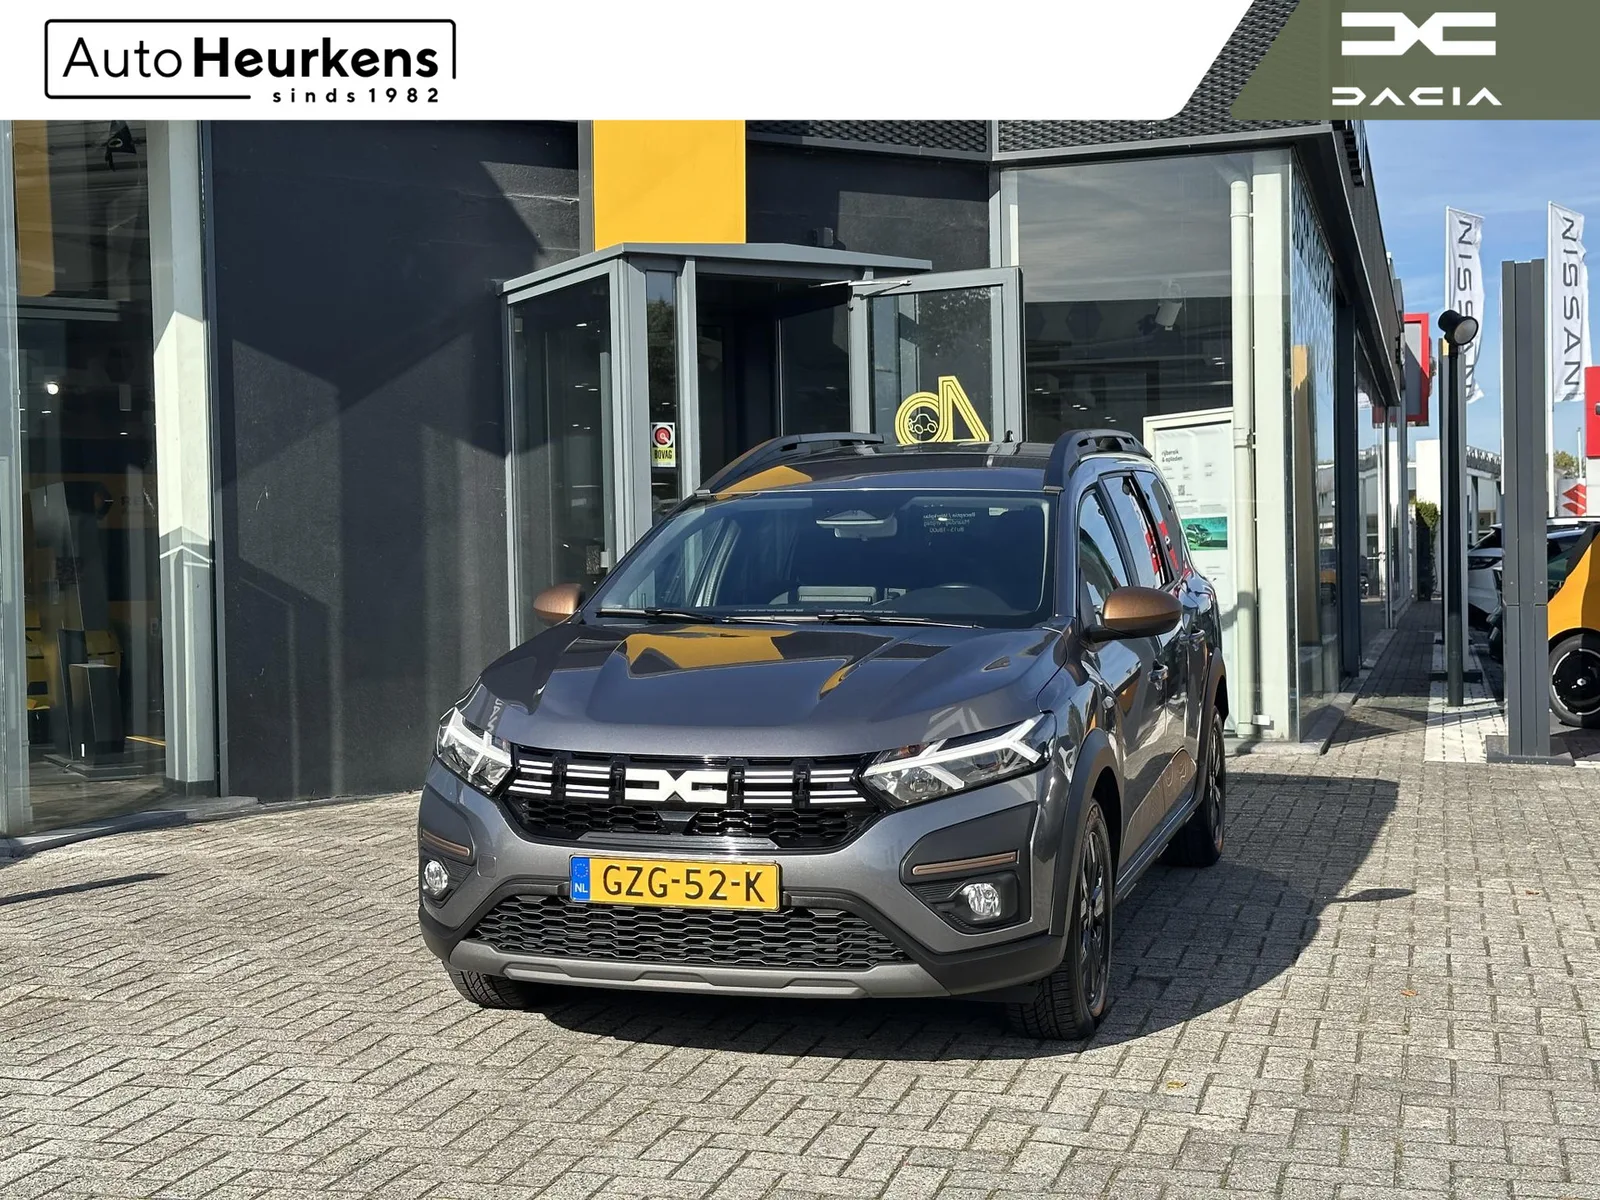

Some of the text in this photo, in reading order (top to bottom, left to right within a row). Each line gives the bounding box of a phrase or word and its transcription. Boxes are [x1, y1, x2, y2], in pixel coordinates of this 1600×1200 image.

[1458, 220, 1474, 389] NISSN
[1562, 216, 1581, 386] NISSAN
[654, 449, 673, 460] BOVAG
[574, 883, 588, 893] NL
[602, 864, 765, 902] GZG-52-K
